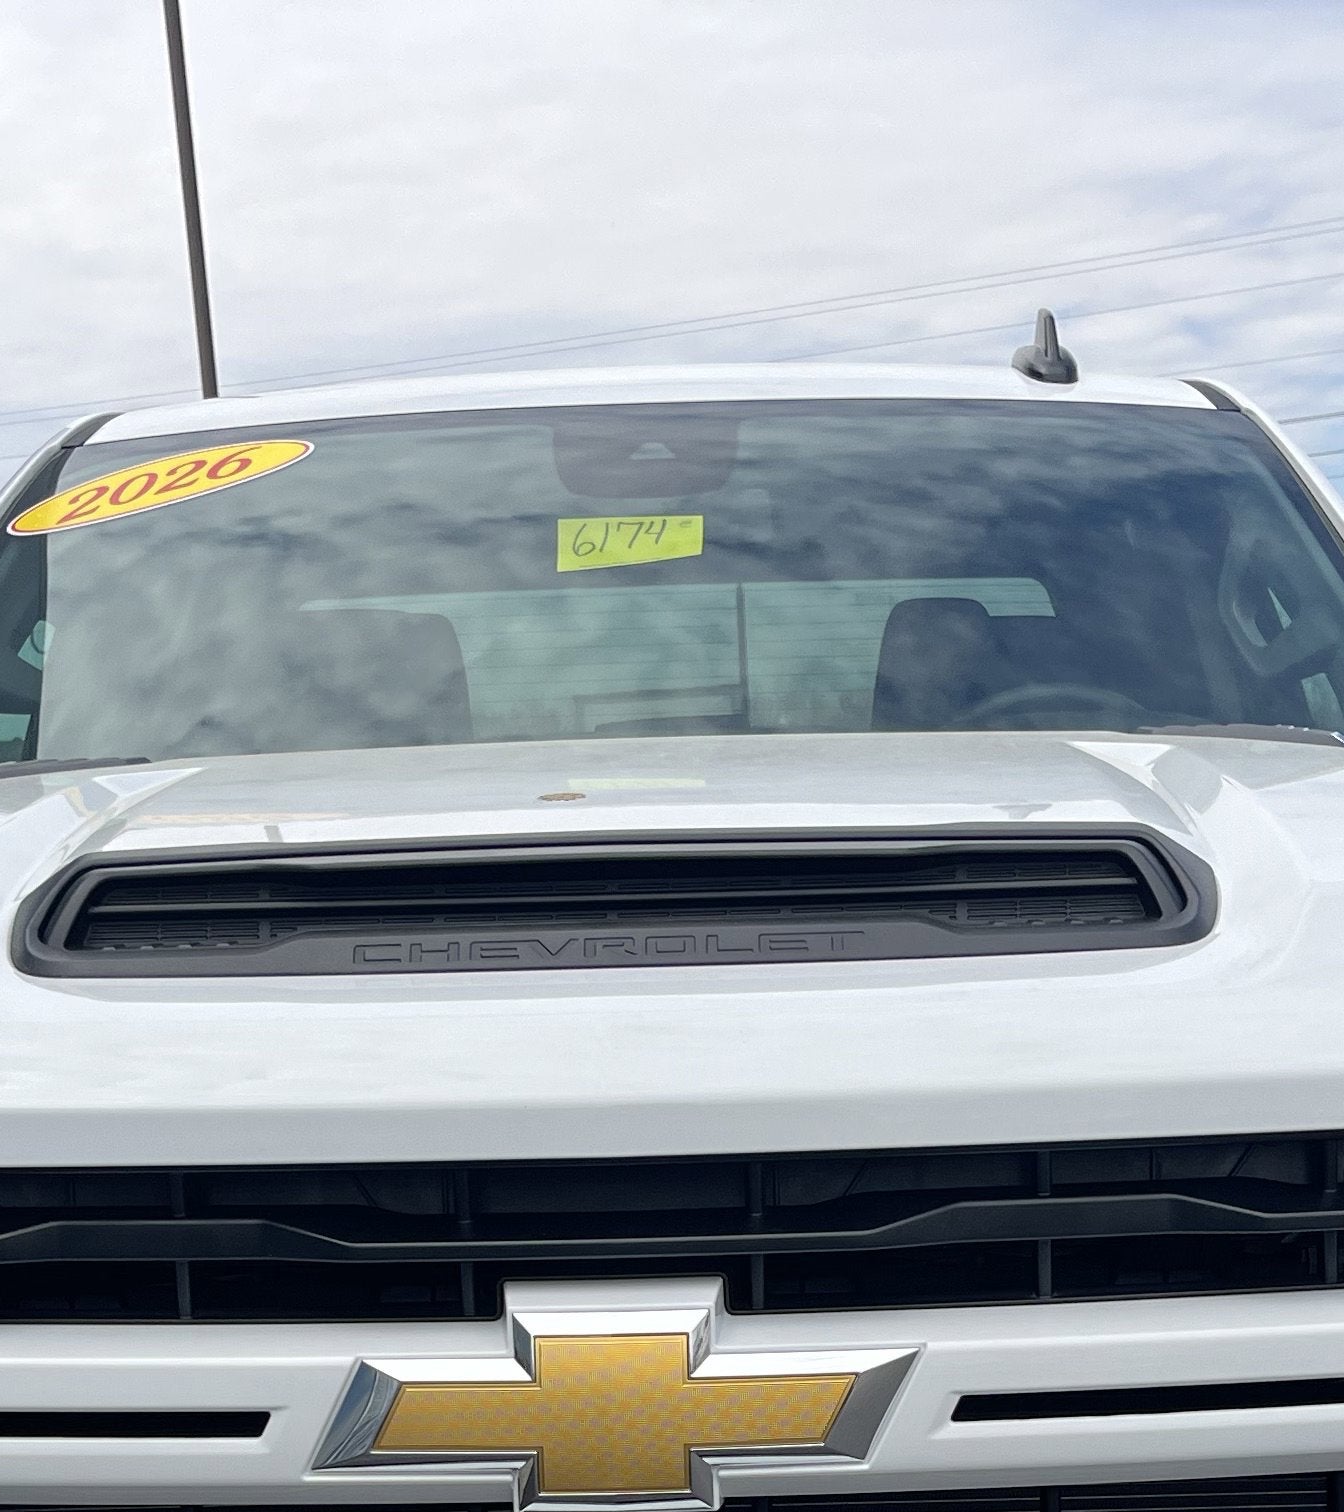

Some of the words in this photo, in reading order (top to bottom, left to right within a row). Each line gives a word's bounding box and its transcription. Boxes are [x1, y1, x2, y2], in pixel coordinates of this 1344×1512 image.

[56, 446, 262, 524] 2026
[572, 519, 667, 557] 6174
[353, 930, 865, 963] CHEVROLET
